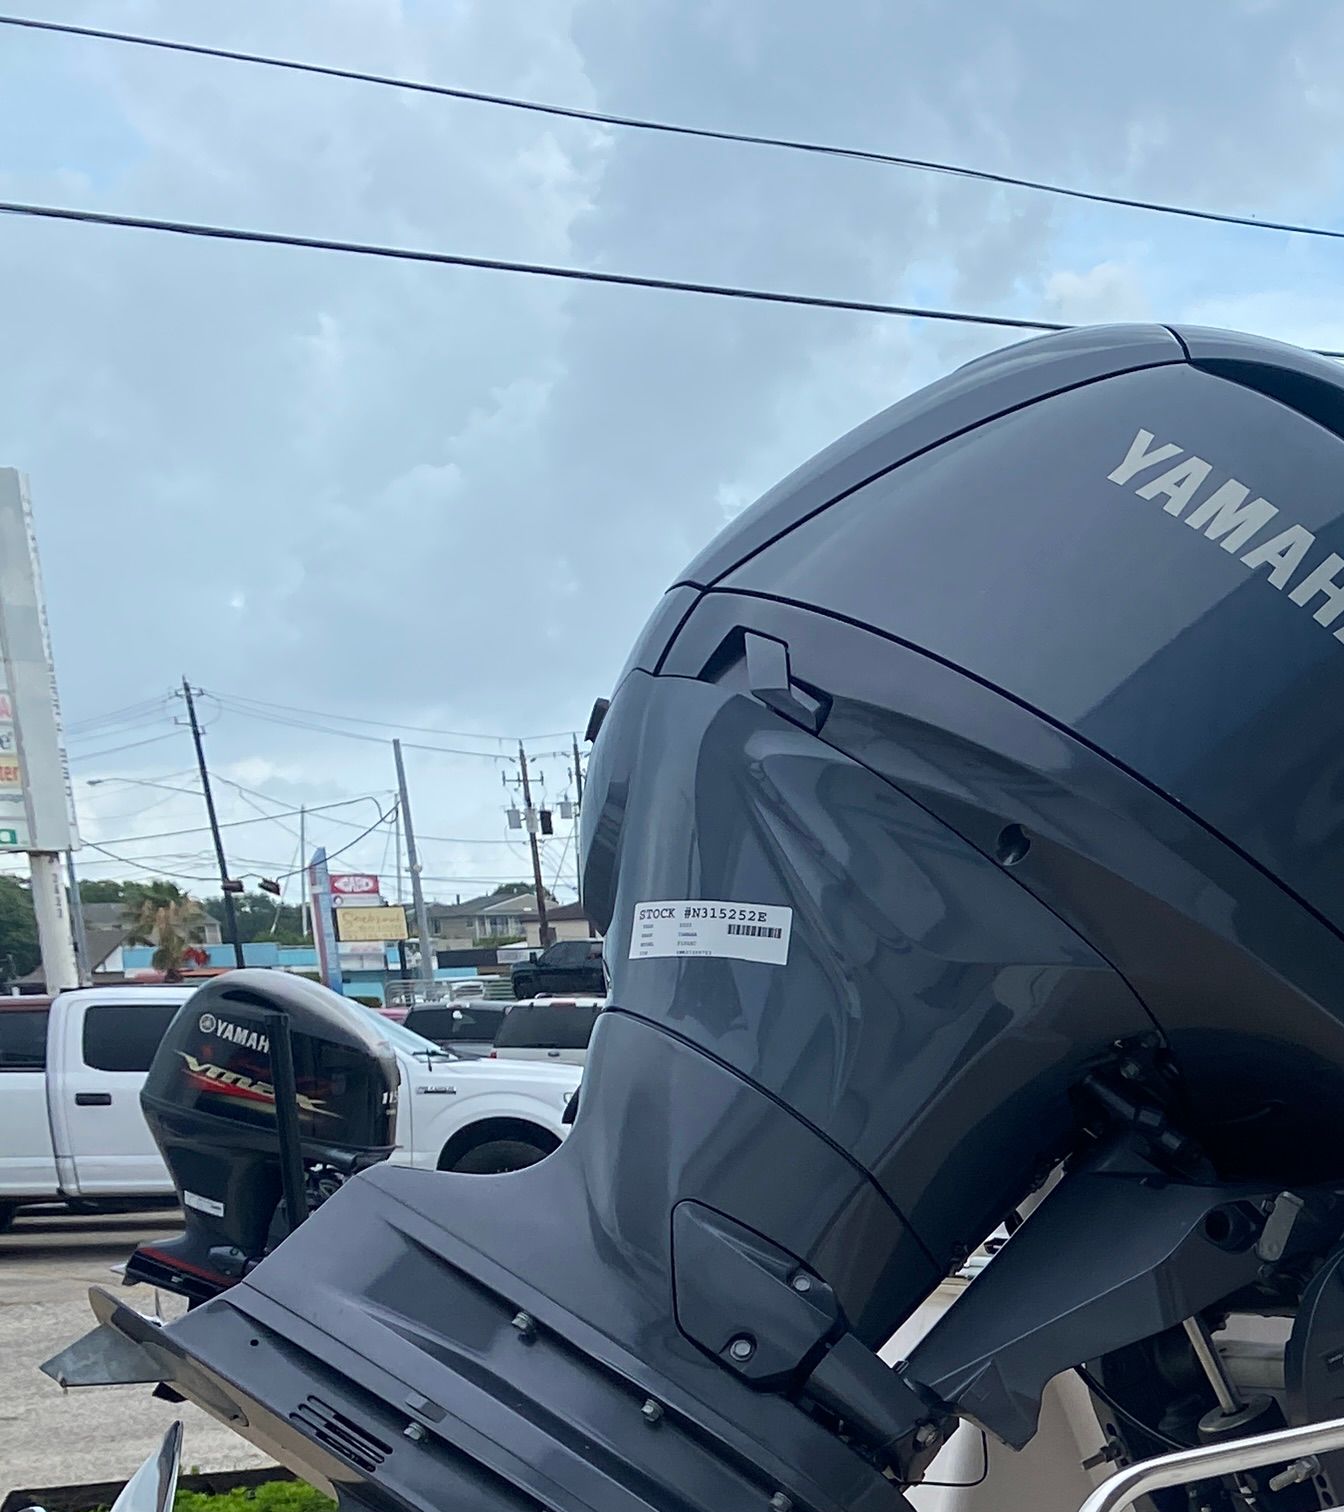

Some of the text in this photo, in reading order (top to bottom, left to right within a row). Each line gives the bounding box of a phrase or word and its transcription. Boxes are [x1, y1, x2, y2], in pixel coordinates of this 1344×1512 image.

[639, 906, 768, 922] STOCK #N315252E
[216, 1018, 270, 1054] YAMAH
